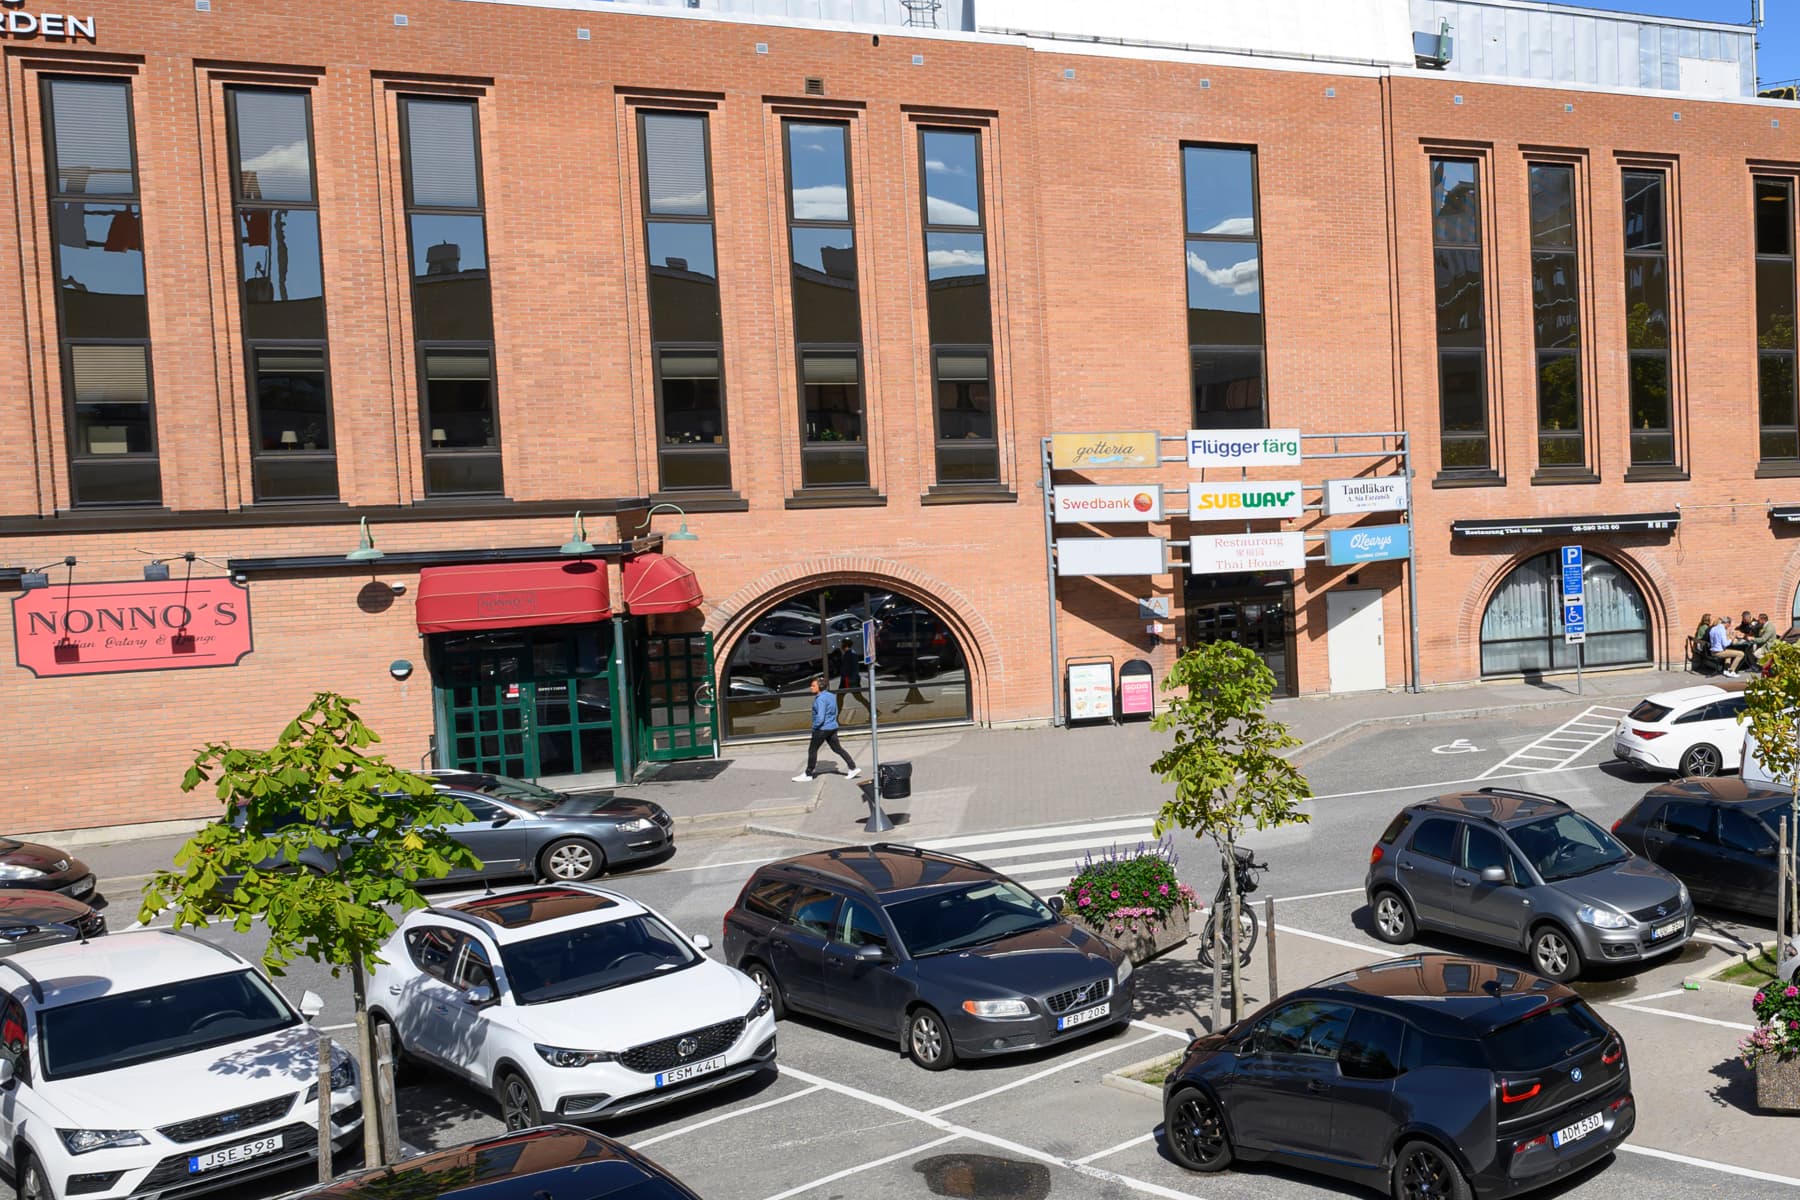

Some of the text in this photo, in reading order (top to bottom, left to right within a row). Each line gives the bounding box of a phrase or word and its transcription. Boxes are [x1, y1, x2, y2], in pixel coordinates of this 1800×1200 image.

[1072, 441, 1135, 463] gotteria
[1191, 438, 1297, 457] Flügger färg
[1341, 483, 1394, 495] Tandläkare
[1062, 497, 1131, 510] Swedbank
[1197, 490, 1296, 510] SUBWAY
[1215, 536, 1284, 548] Restaurang
[1216, 557, 1285, 570] Thai House
[1567, 548, 1579, 564] P
[668, 1060, 720, 1082] ESM 44L
[1562, 1124, 1580, 1142] ADM
[205, 1138, 276, 1166] JSE 598
